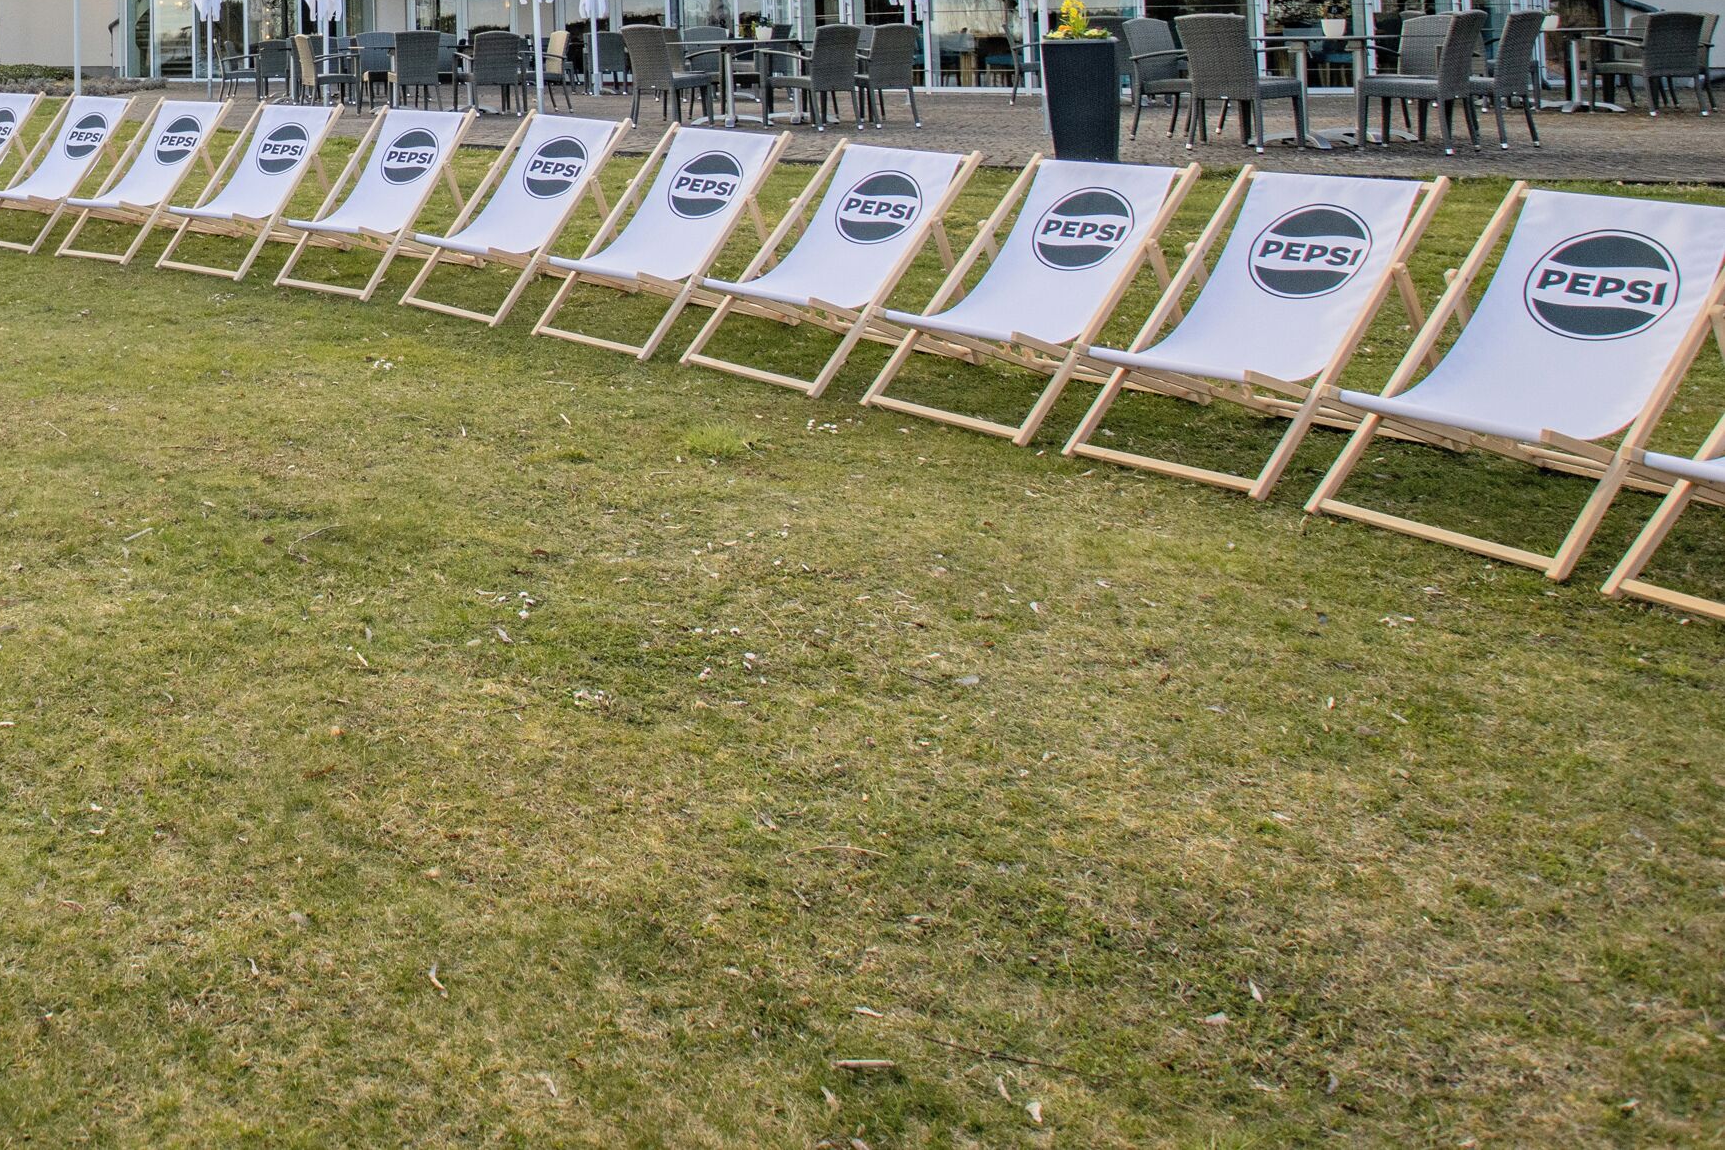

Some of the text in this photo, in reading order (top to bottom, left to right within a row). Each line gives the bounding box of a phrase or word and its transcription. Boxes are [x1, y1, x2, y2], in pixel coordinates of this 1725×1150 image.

[69, 131, 104, 143] PEPSI
[160, 135, 198, 147] PEPSI
[261, 143, 304, 156] PEPSI
[386, 150, 434, 164] PEPSI
[529, 159, 582, 178] PEPSI
[675, 176, 736, 196] PEPSI
[843, 197, 915, 220] PEPSI
[1041, 219, 1126, 241] PEPSI
[1258, 239, 1363, 266] PEPSI
[1536, 268, 1668, 306] PEPSI
